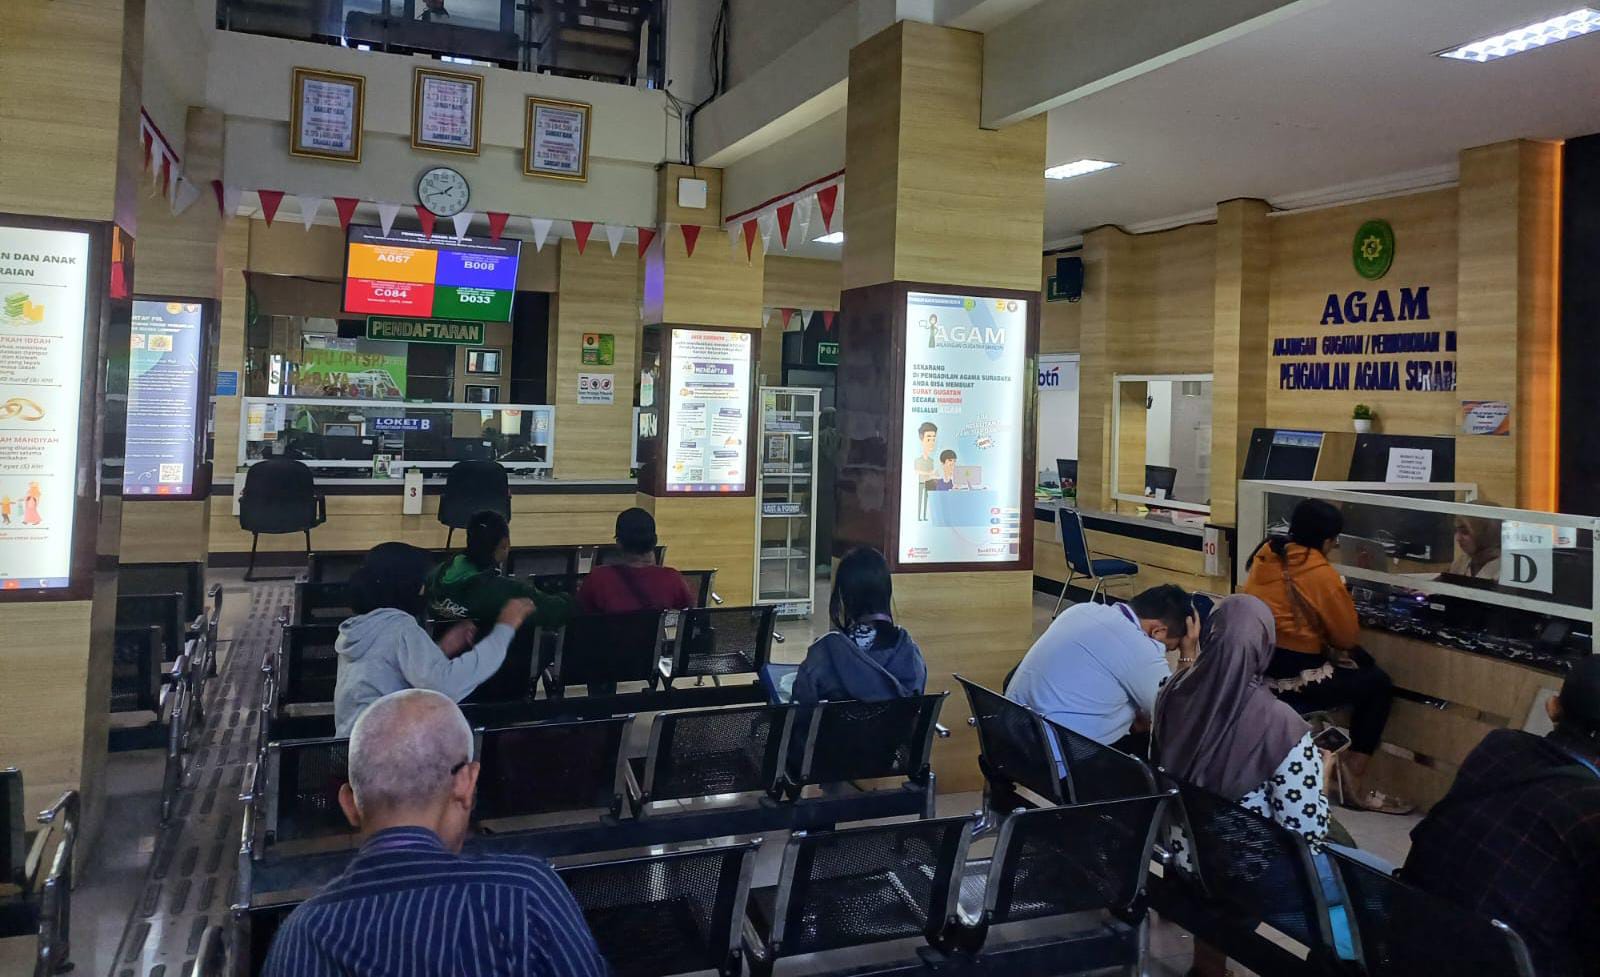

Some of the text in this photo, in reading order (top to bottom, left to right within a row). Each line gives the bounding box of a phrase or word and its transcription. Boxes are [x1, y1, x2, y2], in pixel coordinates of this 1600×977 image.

[14, 253, 40, 262] DAN
[42, 255, 76, 265] ANAK
[377, 253, 411, 263] A057
[464, 261, 495, 271] B008
[374, 288, 407, 298] C084
[460, 294, 491, 304] D033
[1320, 286, 1430, 325] AGAM
[372, 320, 479, 341] PENDAFTARAN
[936, 327, 1006, 344] AGAM
[820, 346, 839, 355] POJ
[1322, 335, 1363, 355] GUGATAN
[1280, 362, 1350, 390] PENGADILAN
[1354, 361, 1400, 390] AGAMA
[376, 418, 431, 431] LOKET B
[410, 487, 417, 498] 3
[1205, 542, 1216, 555] 10
[1508, 552, 1538, 584] D
